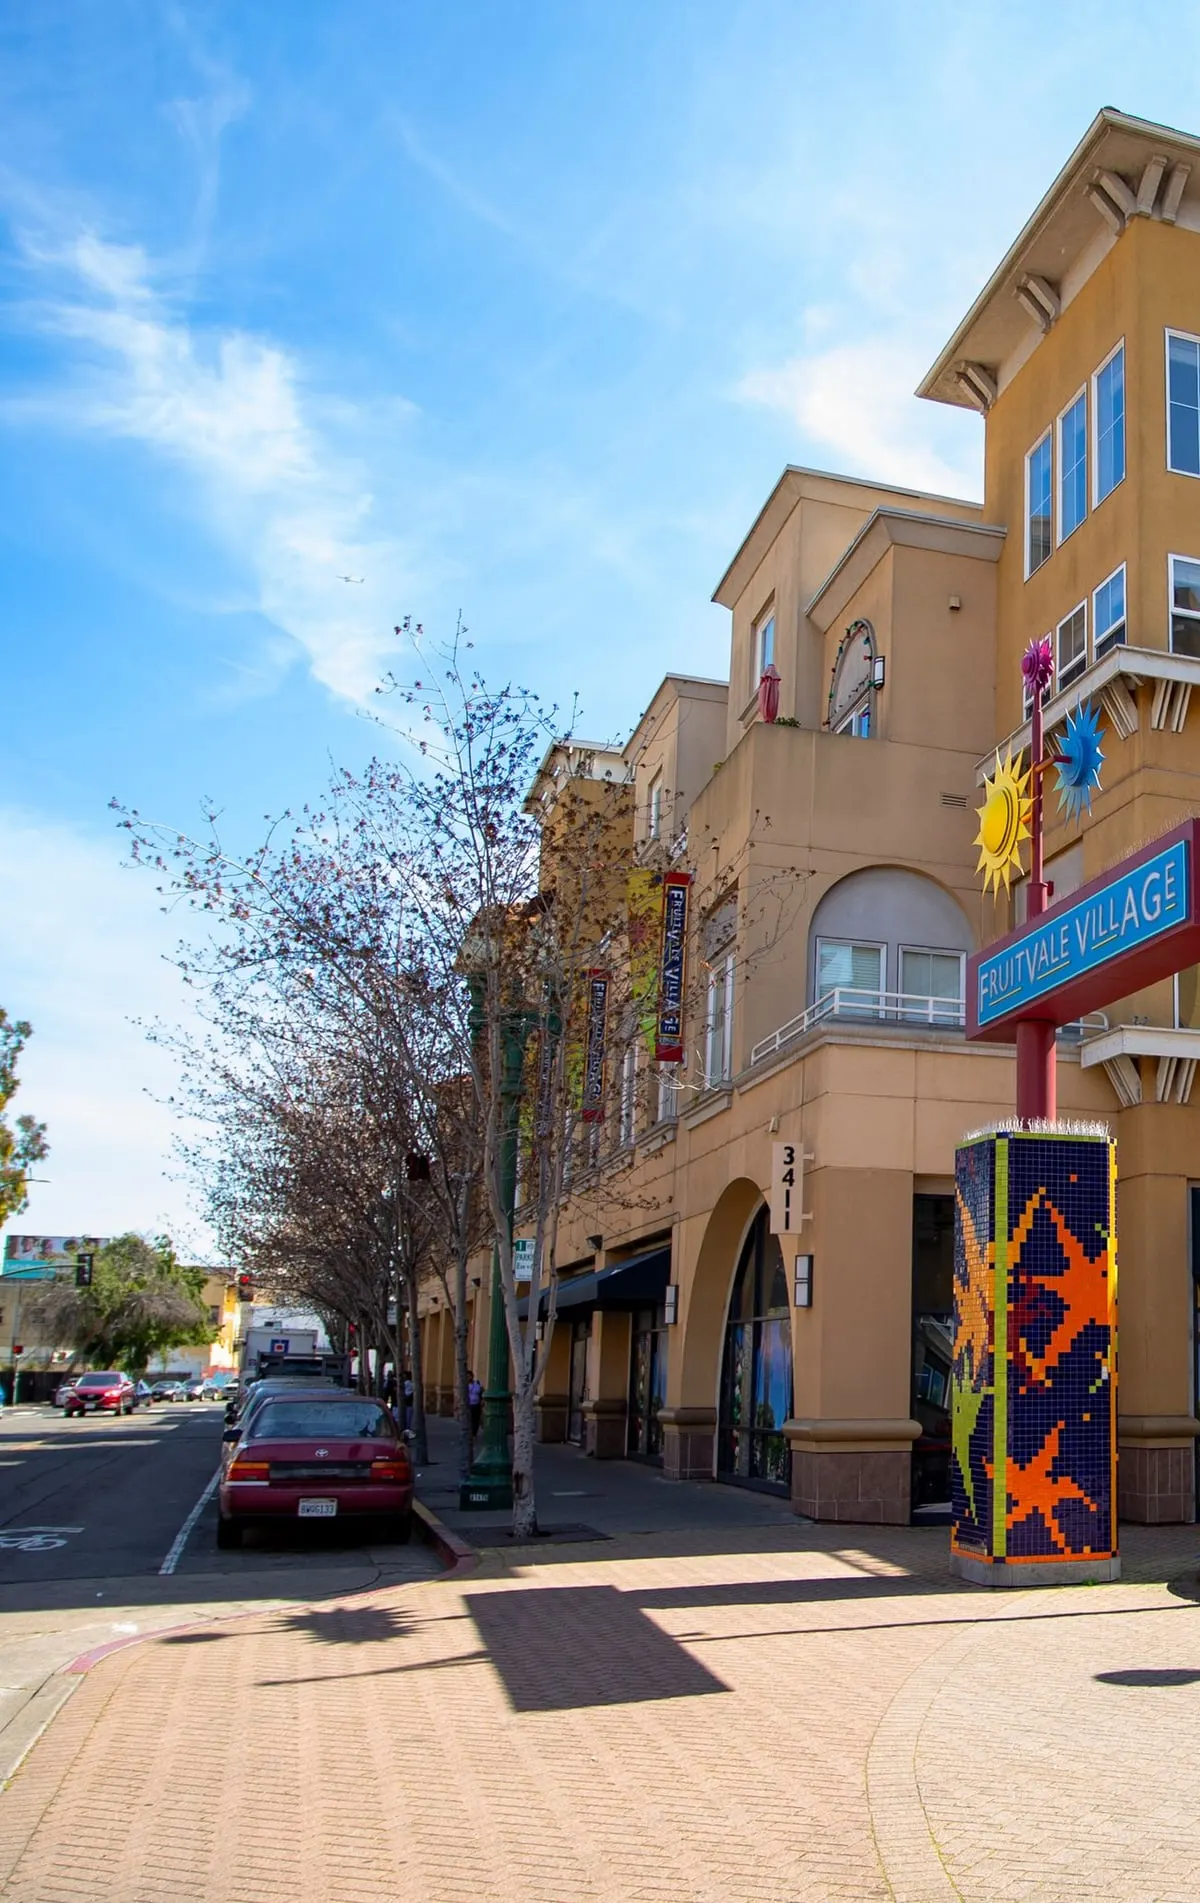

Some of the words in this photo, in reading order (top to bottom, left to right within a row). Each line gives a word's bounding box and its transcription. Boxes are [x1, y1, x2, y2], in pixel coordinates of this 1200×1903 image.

[979, 924, 1070, 1013] FRUITVALE
[1074, 861, 1176, 957] VILLAGE
[781, 1145, 796, 1231] 3411
